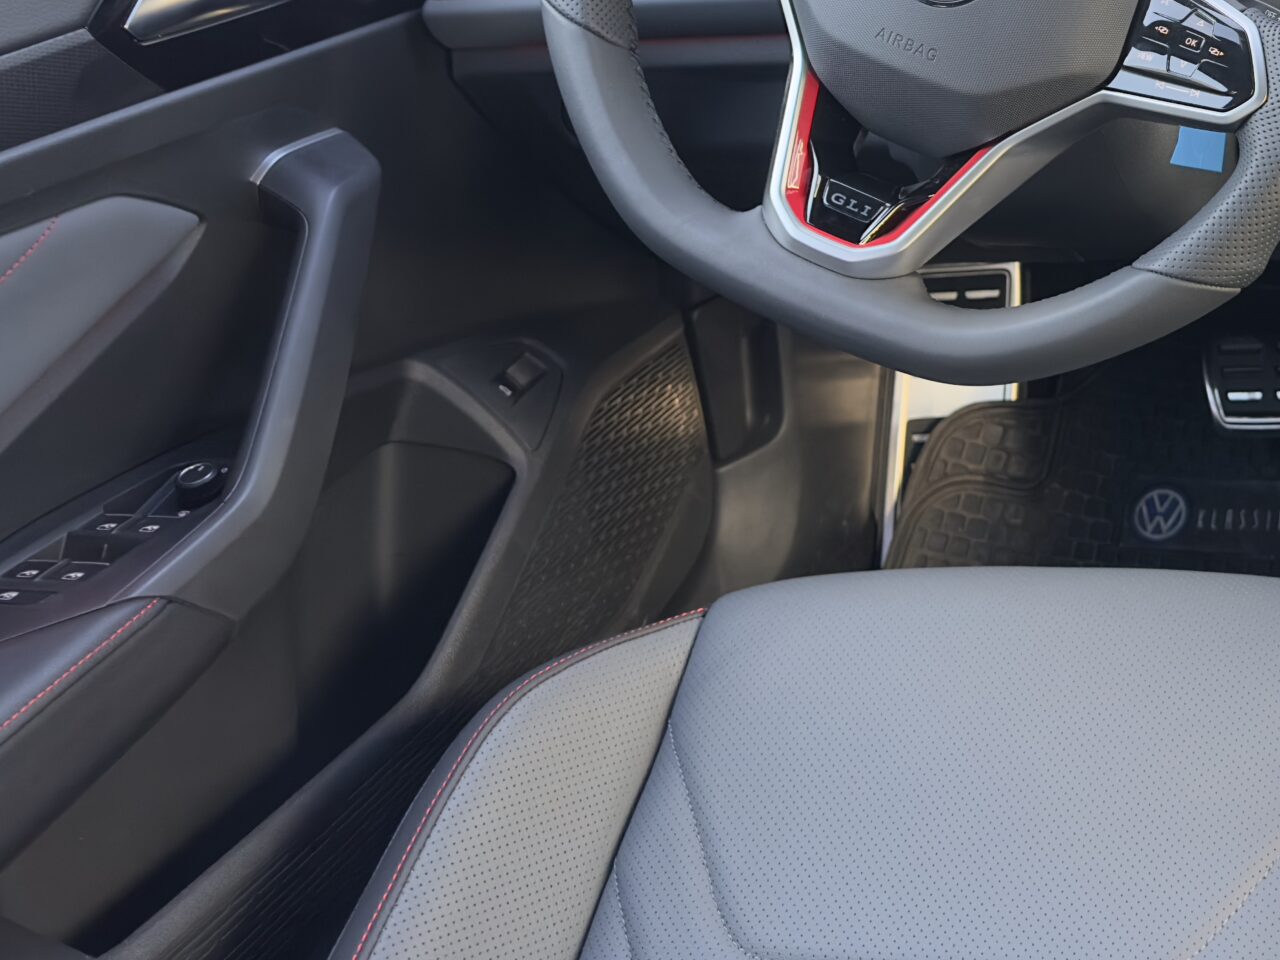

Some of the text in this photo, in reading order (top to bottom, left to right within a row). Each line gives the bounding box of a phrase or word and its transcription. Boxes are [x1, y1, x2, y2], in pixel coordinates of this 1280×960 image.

[874, 27, 938, 61] AIRBAG
[1184, 37, 1198, 48] OK
[831, 192, 872, 216] GLI
